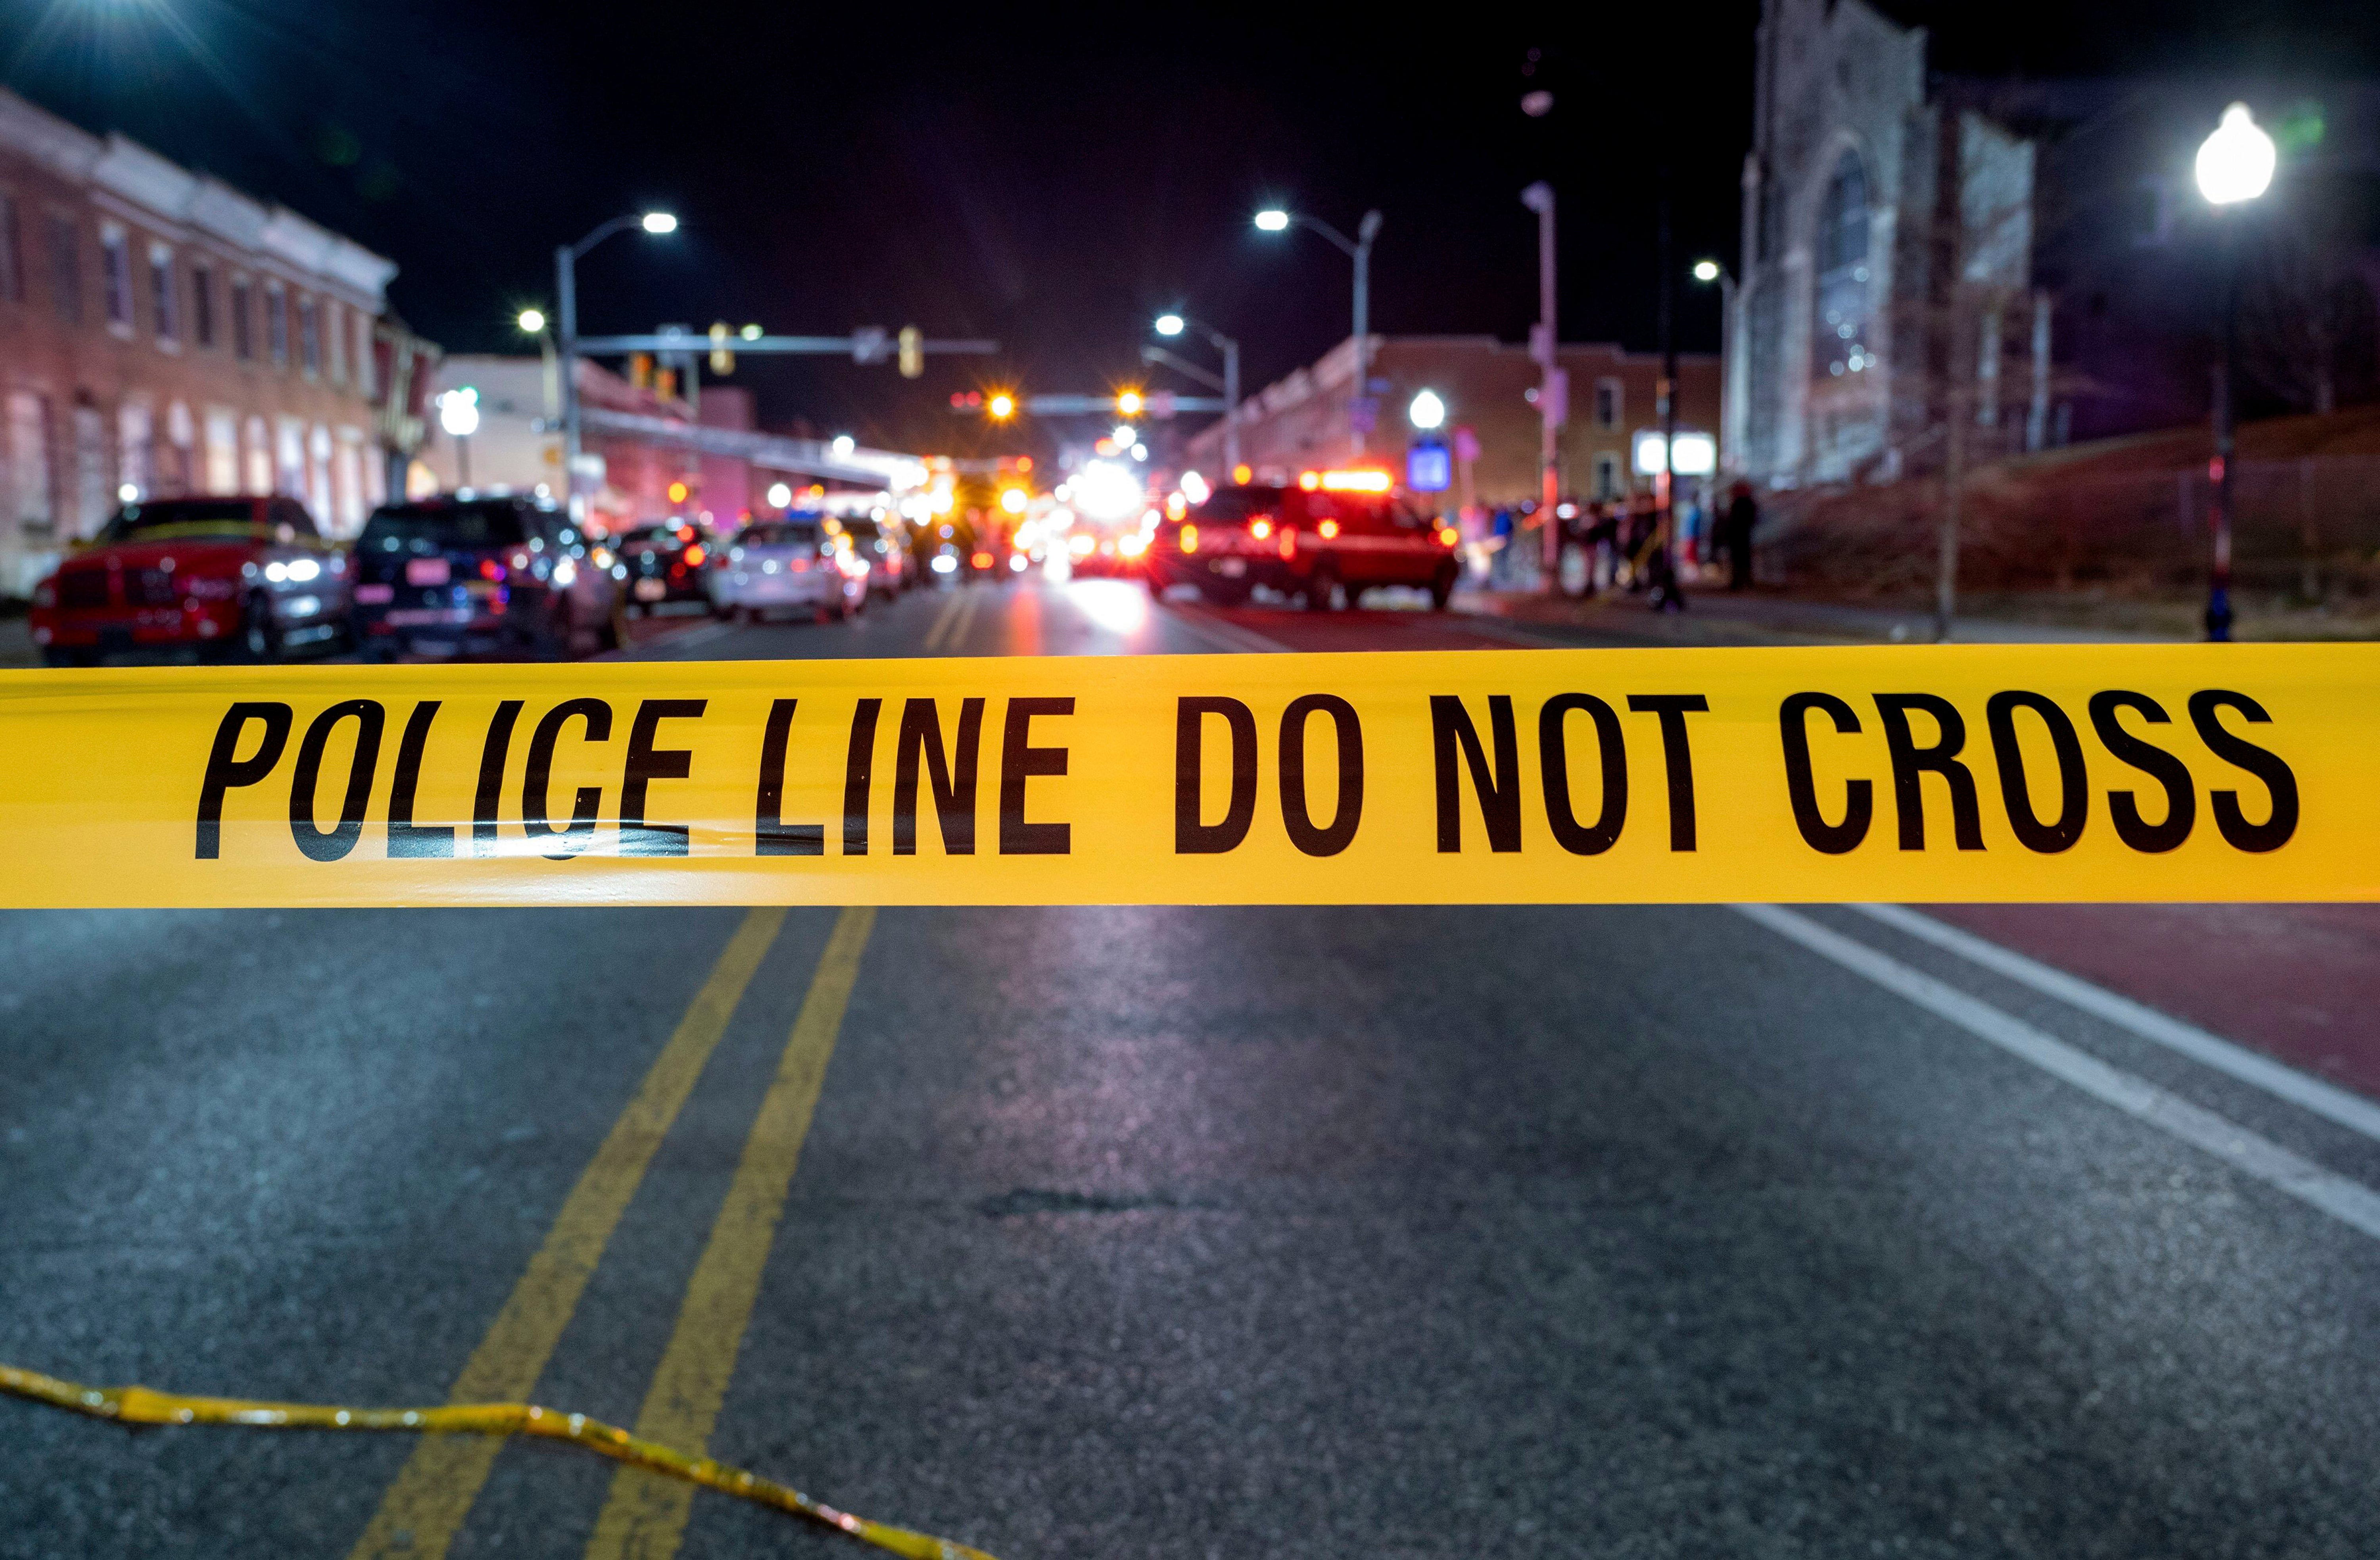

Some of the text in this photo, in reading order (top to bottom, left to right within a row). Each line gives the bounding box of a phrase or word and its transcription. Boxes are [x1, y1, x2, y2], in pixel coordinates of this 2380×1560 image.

[195, 689, 2299, 862] POLICE LINE DO NOT CROSS
